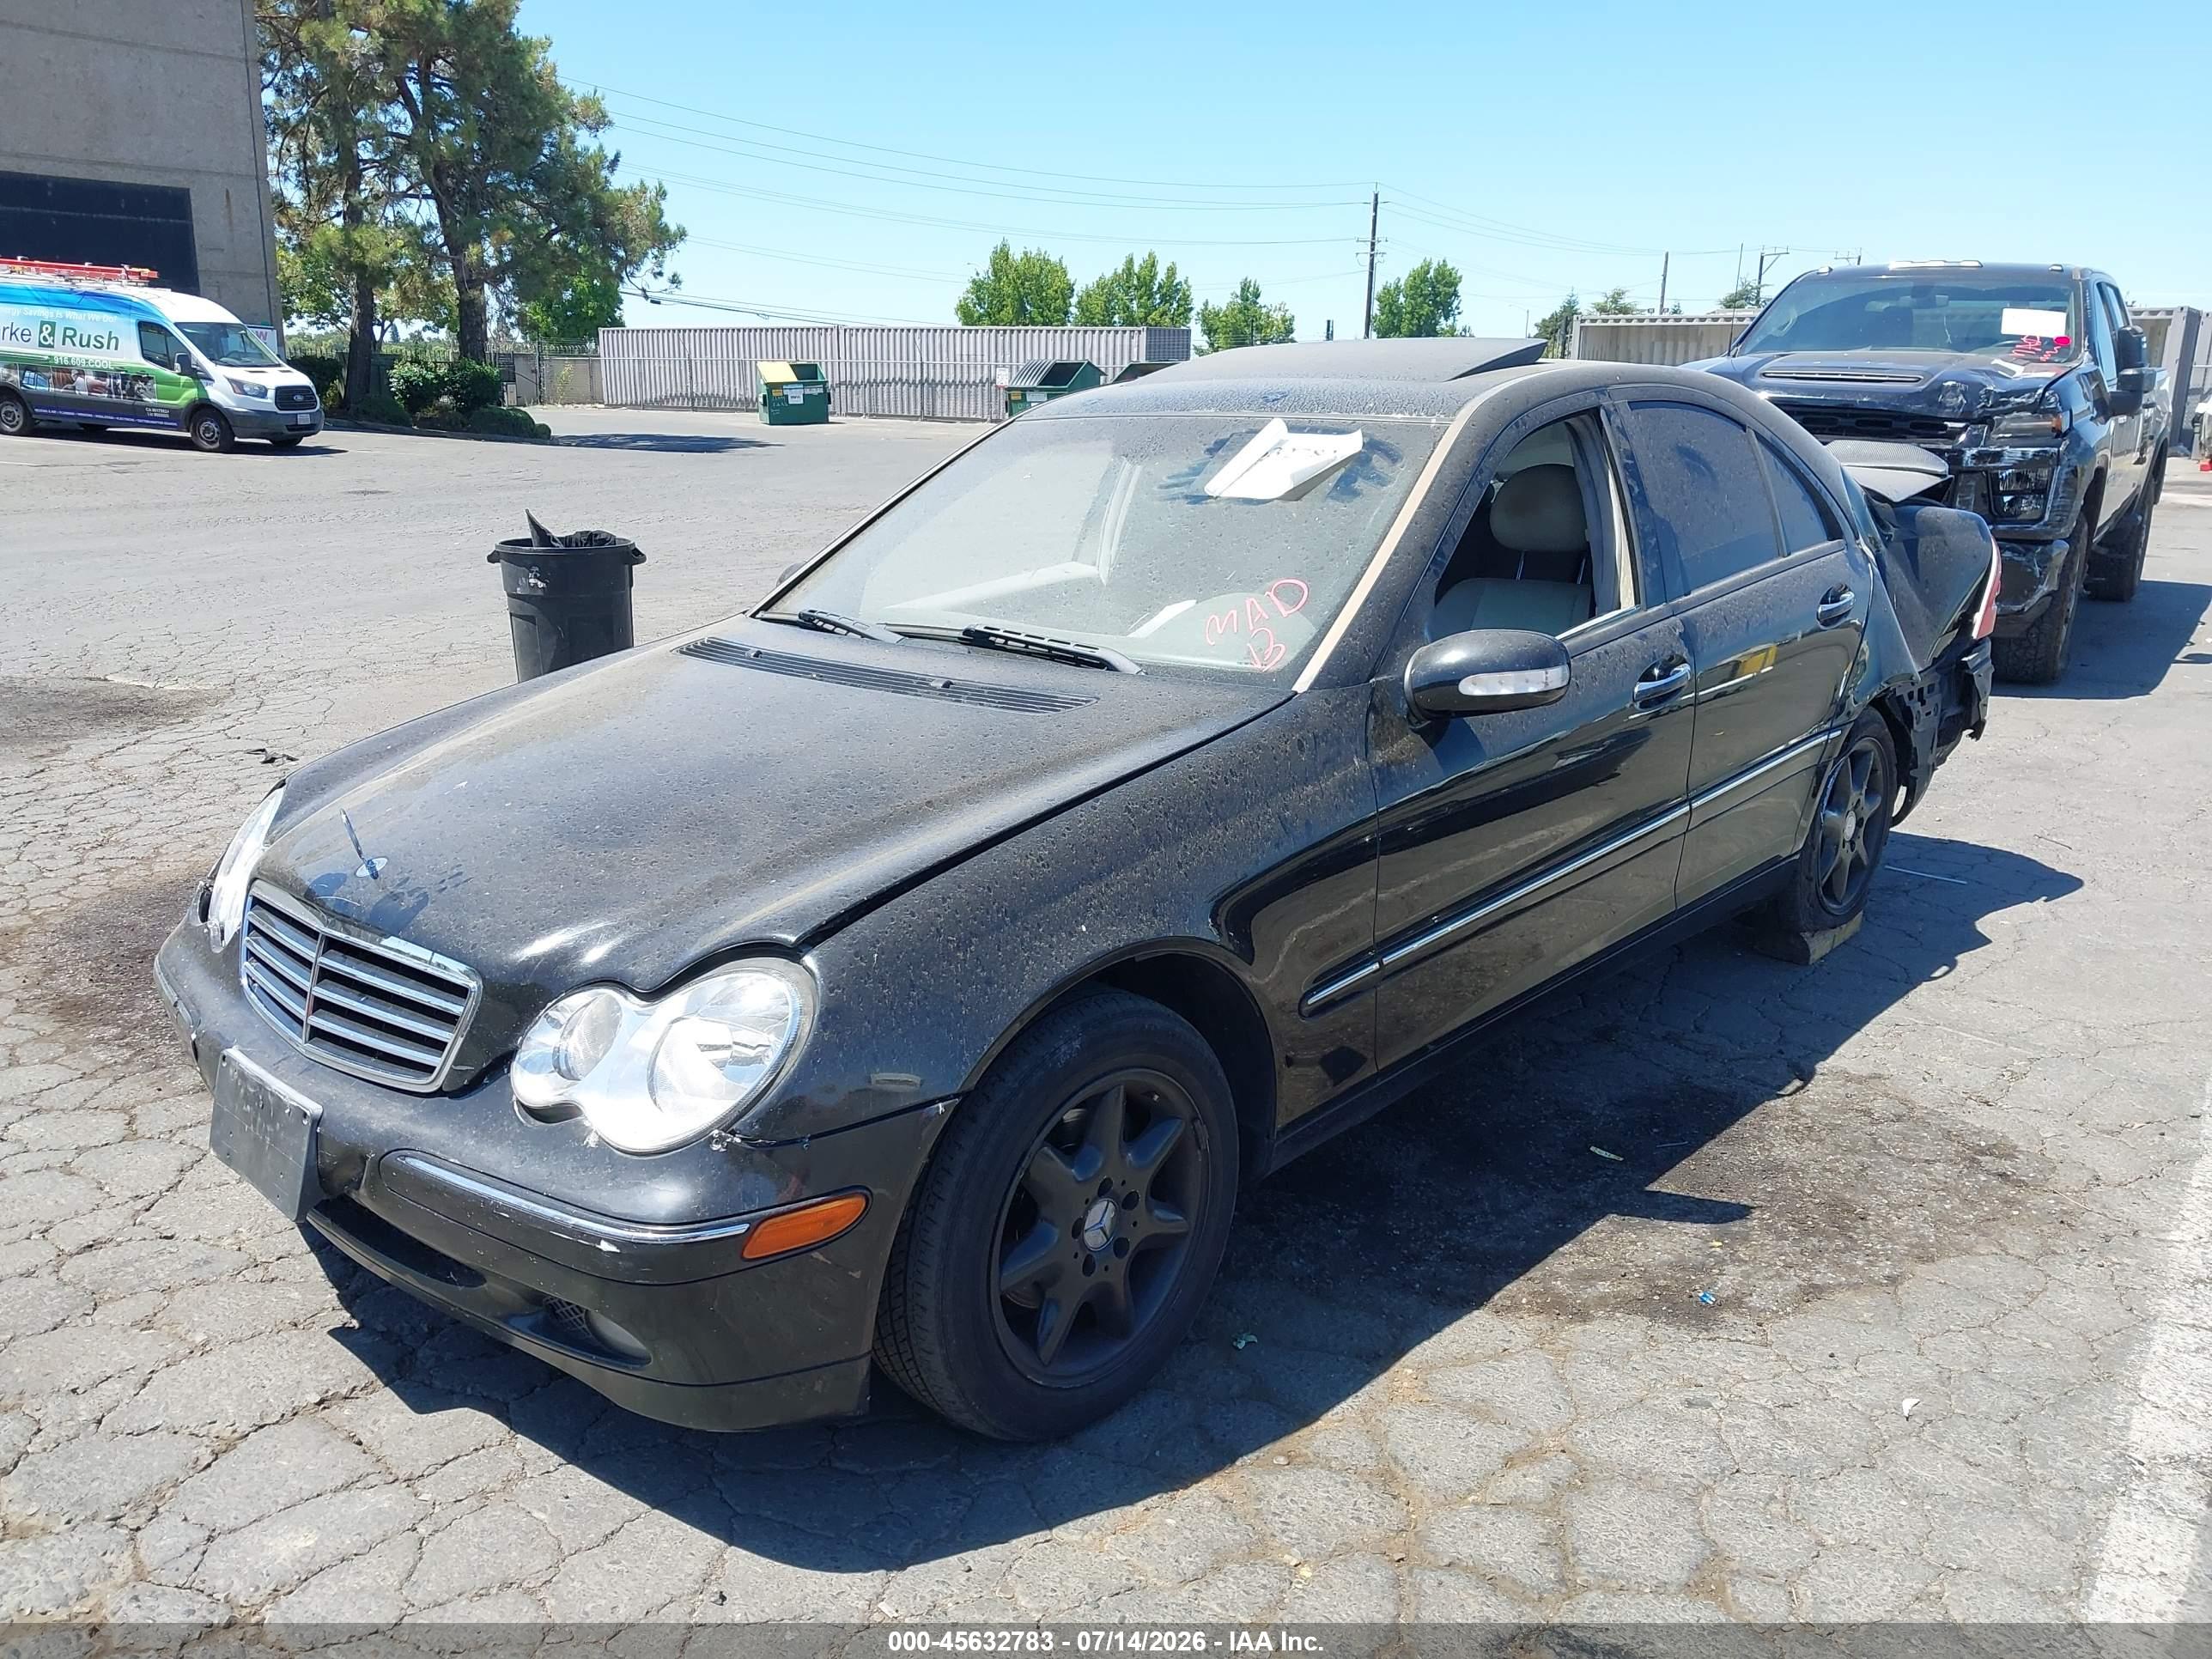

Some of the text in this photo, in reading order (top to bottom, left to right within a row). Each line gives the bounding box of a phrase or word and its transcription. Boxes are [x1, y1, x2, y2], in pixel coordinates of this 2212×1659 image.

[40, 323, 54, 345] &
[62, 326, 119, 350] Rush
[53, 356, 114, 369] 916.609.COOL
[1206, 579, 1309, 646] MAD
